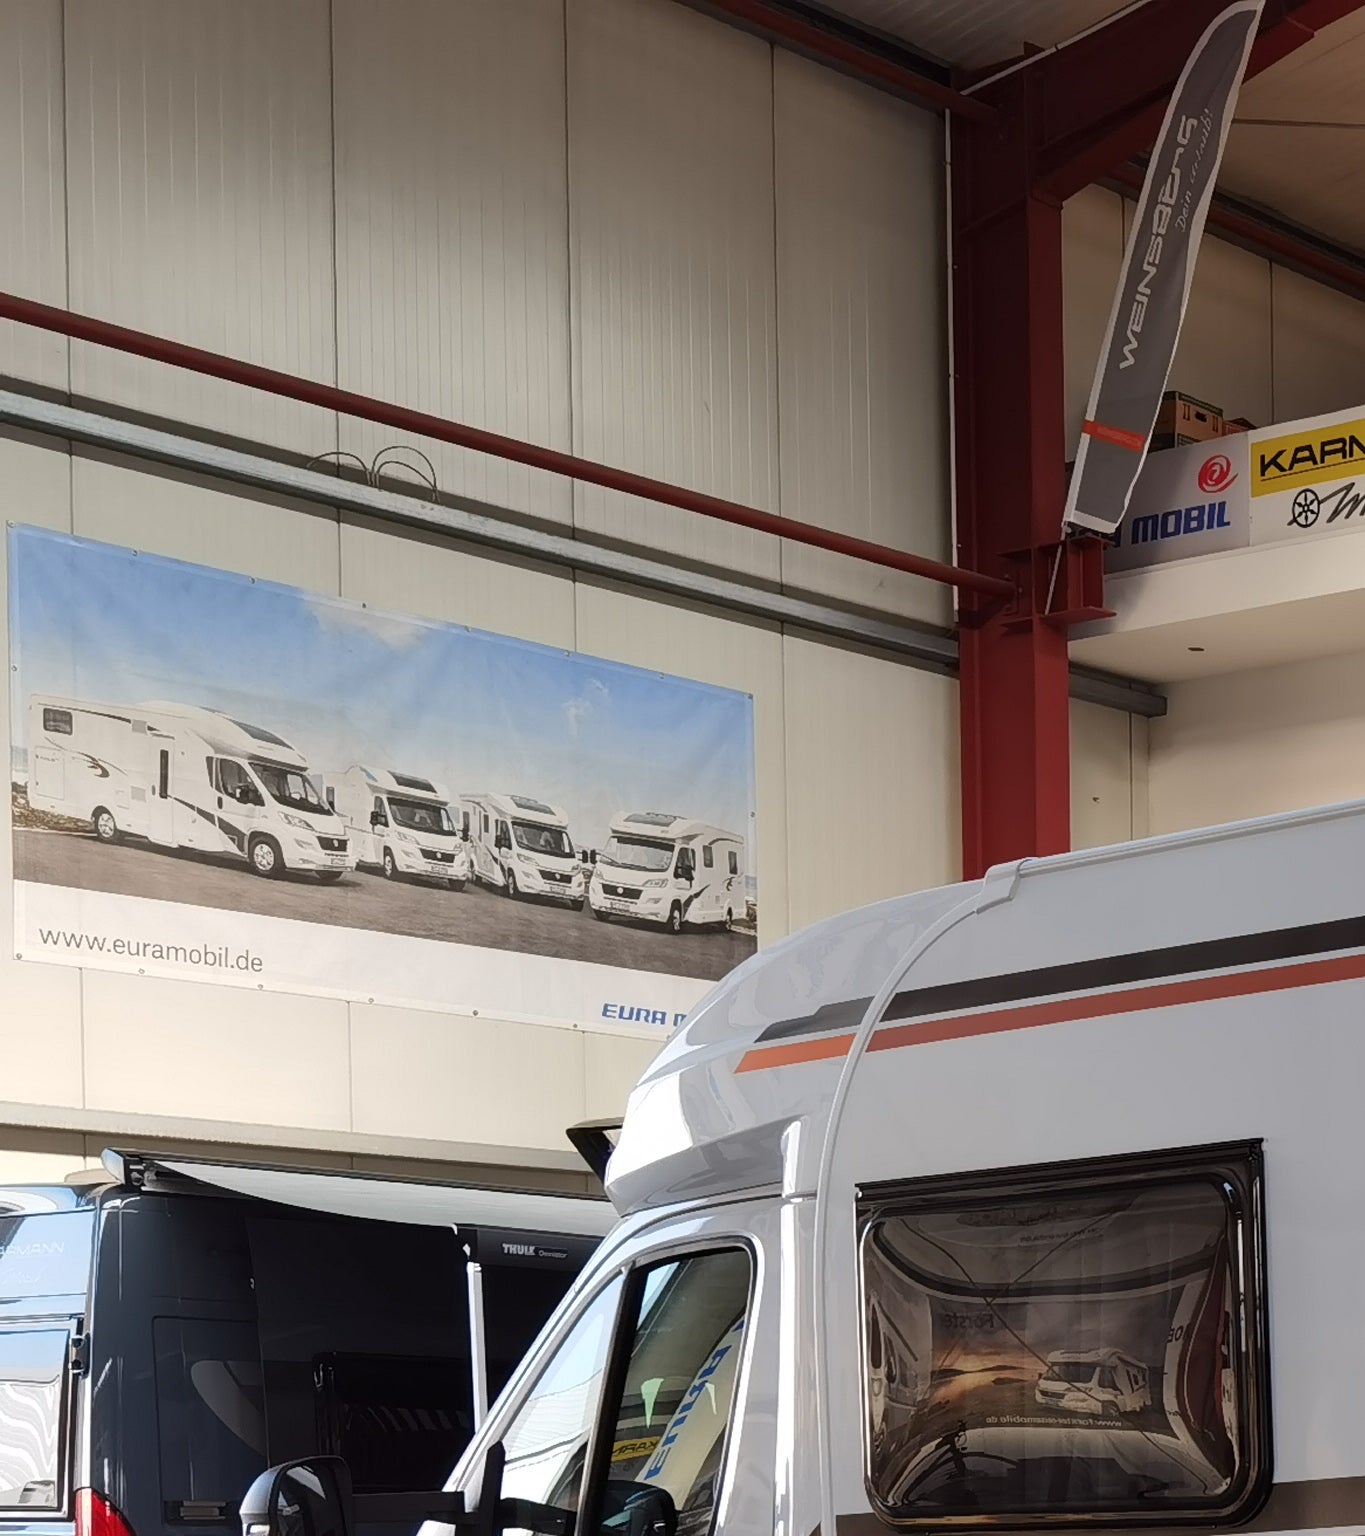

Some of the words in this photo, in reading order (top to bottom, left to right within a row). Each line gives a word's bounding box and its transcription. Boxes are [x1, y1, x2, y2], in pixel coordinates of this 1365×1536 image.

[1174, 188, 1193, 233] Dein
[1119, 114, 1198, 370] WEINSBERG
[1130, 500, 1231, 546] MOBIL
[39, 927, 263, 973] www.euramobil.de
[601, 1003, 667, 1025] EURA
[502, 1242, 536, 1256] THULE
